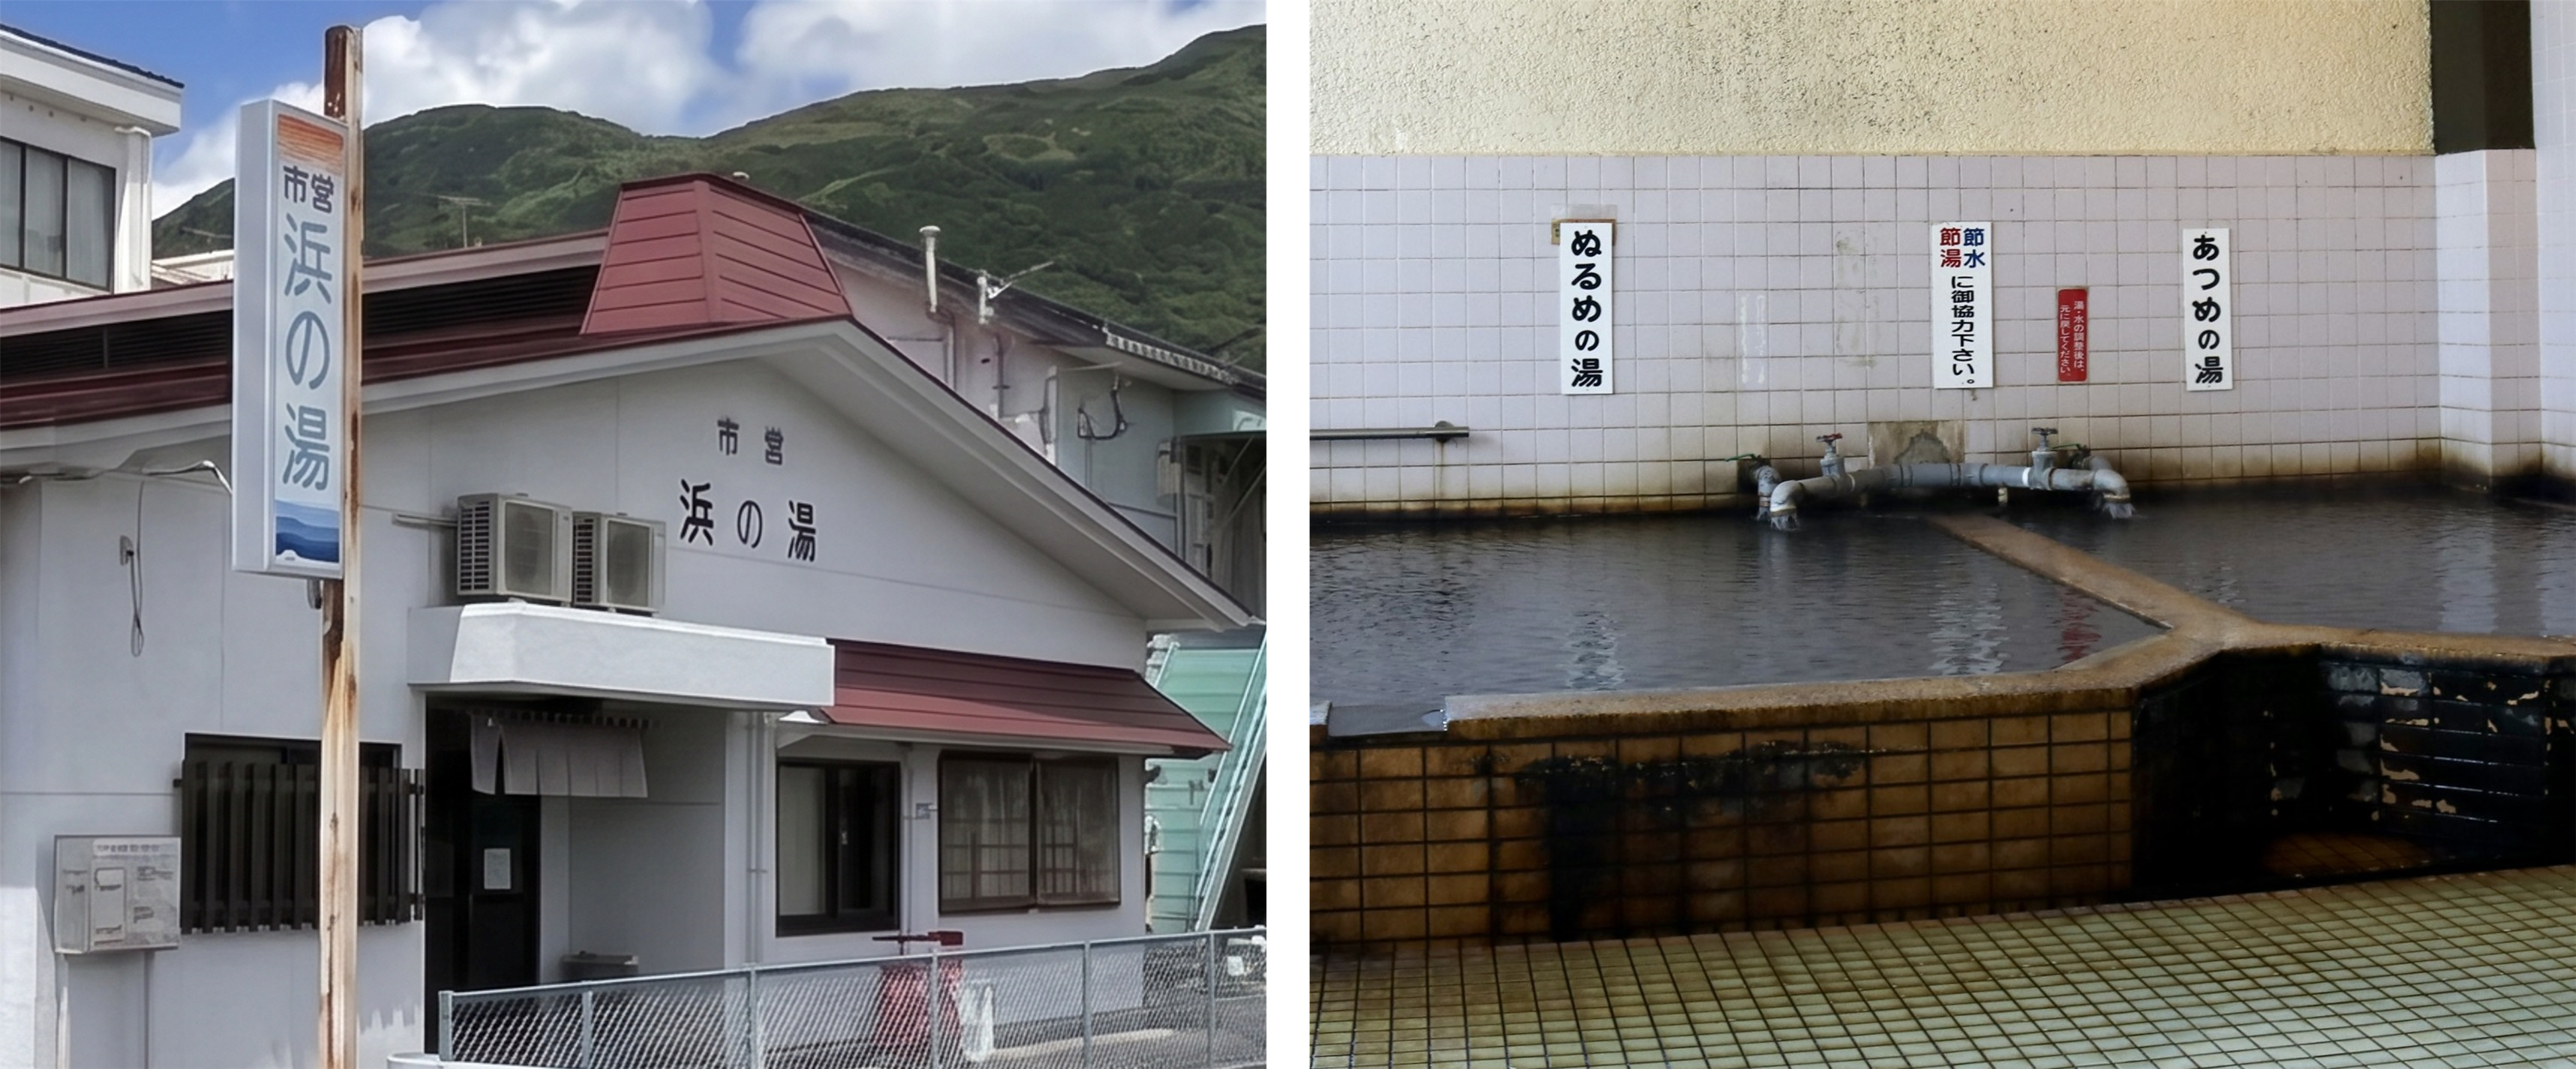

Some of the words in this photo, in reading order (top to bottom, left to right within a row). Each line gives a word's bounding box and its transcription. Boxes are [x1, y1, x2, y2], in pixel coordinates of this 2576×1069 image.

[283, 165, 334, 213] 市営
[1939, 227, 1962, 268] 節湯
[1963, 227, 1986, 268] 節水
[1571, 229, 1603, 387] ぬるめの湯
[1951, 276, 1974, 384] に御協力下さい。
[2192, 235, 2224, 384] あつめの湯
[283, 213, 333, 491] 浜の湯
[717, 418, 784, 466] 市営
[680, 478, 816, 562] 浜の湯
